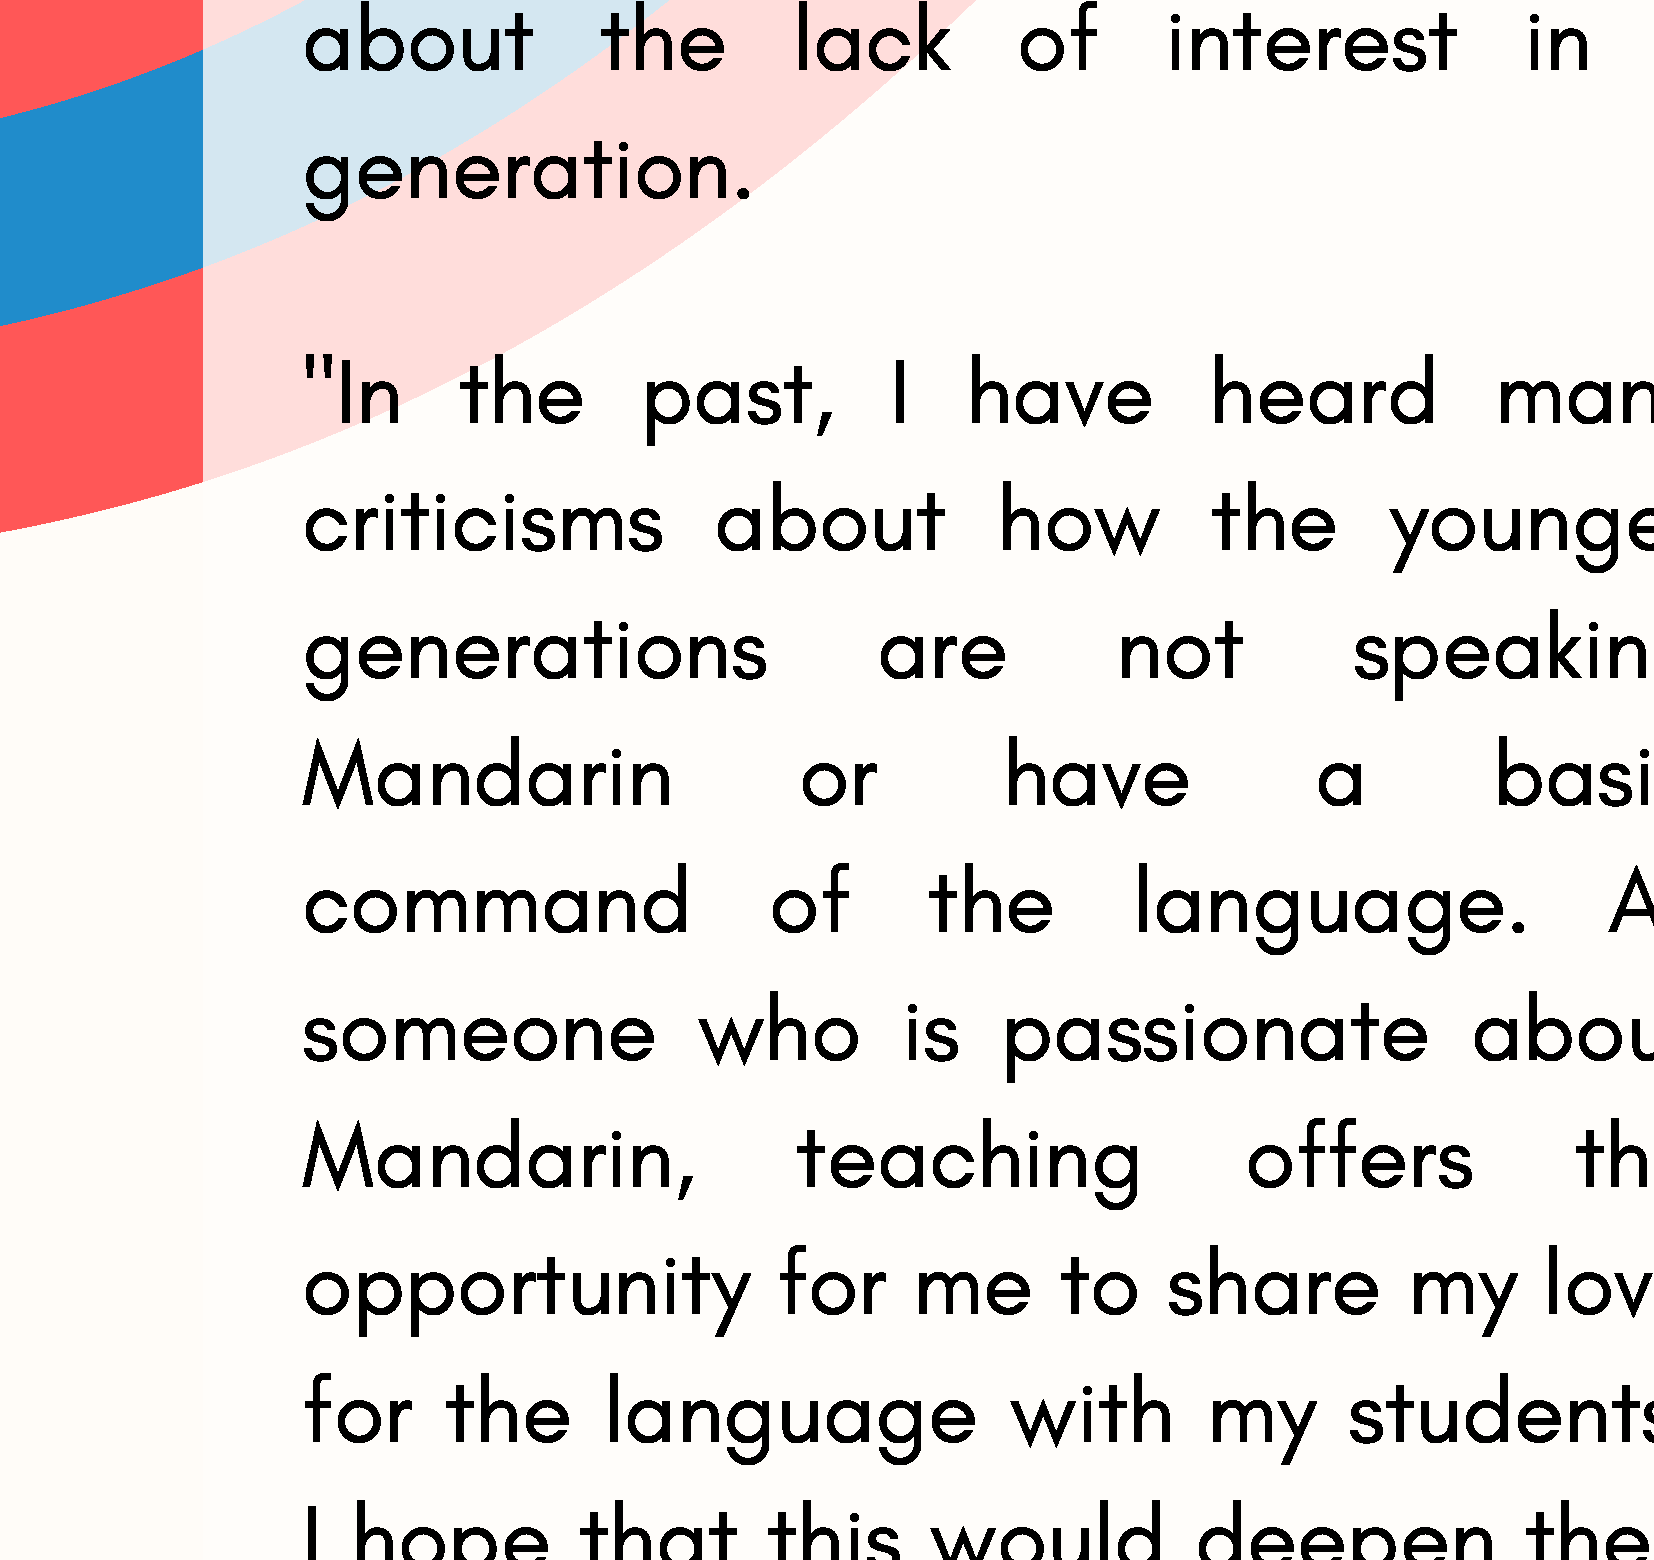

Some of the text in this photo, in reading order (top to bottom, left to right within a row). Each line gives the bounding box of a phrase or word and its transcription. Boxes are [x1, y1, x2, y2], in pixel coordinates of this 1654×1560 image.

[306, 1, 533, 71] about
[601, 1, 724, 71] the
[799, 1, 951, 71] lack
[1021, 1, 1097, 71] of
[1171, 13, 1457, 72] interest
[1530, 14, 1587, 70] in
[306, 141, 749, 221] generation.
[306, 354, 398, 423] "In
[460, 354, 582, 424] the
[647, 366, 832, 446] past,
[896, 360, 904, 423] I
[972, 354, 1151, 427] have
[1215, 354, 1433, 424] heard
[306, 493, 662, 552] criticisms
[718, 481, 945, 551] about
[1003, 481, 1160, 556] how
[1212, 481, 1335, 551] the
[306, 621, 766, 701] generations
[881, 636, 1005, 679] are
[1122, 621, 1243, 679] not
[302, 736, 669, 809] Mandarin
[803, 763, 877, 806] or
[1009, 736, 1188, 809] have
[1319, 763, 1361, 806] a
[306, 863, 686, 933] command
[773, 863, 849, 933] of
[929, 863, 1052, 933] the
[1139, 863, 1524, 955] language.
[304, 1018, 654, 1062] someone
[698, 991, 858, 1066] who
[908, 1004, 958, 1062] is
[1007, 1003, 1427, 1083] passionate
[302, 1118, 693, 1200] Mandarin,
[797, 1118, 1137, 1210] teaching
[1249, 1118, 1472, 1189] offers
[306, 1257, 751, 1337] opportunity
[780, 1245, 886, 1315] for
[919, 1272, 1030, 1315] me
[1061, 1257, 1137, 1315] to
[1169, 1245, 1378, 1316] share
[1414, 1272, 1518, 1337] my
[305, 1373, 412, 1443] for
[446, 1373, 569, 1443] the
[610, 1373, 975, 1465] language
[1010, 1373, 1170, 1448] with
[1213, 1400, 1317, 1465] my
